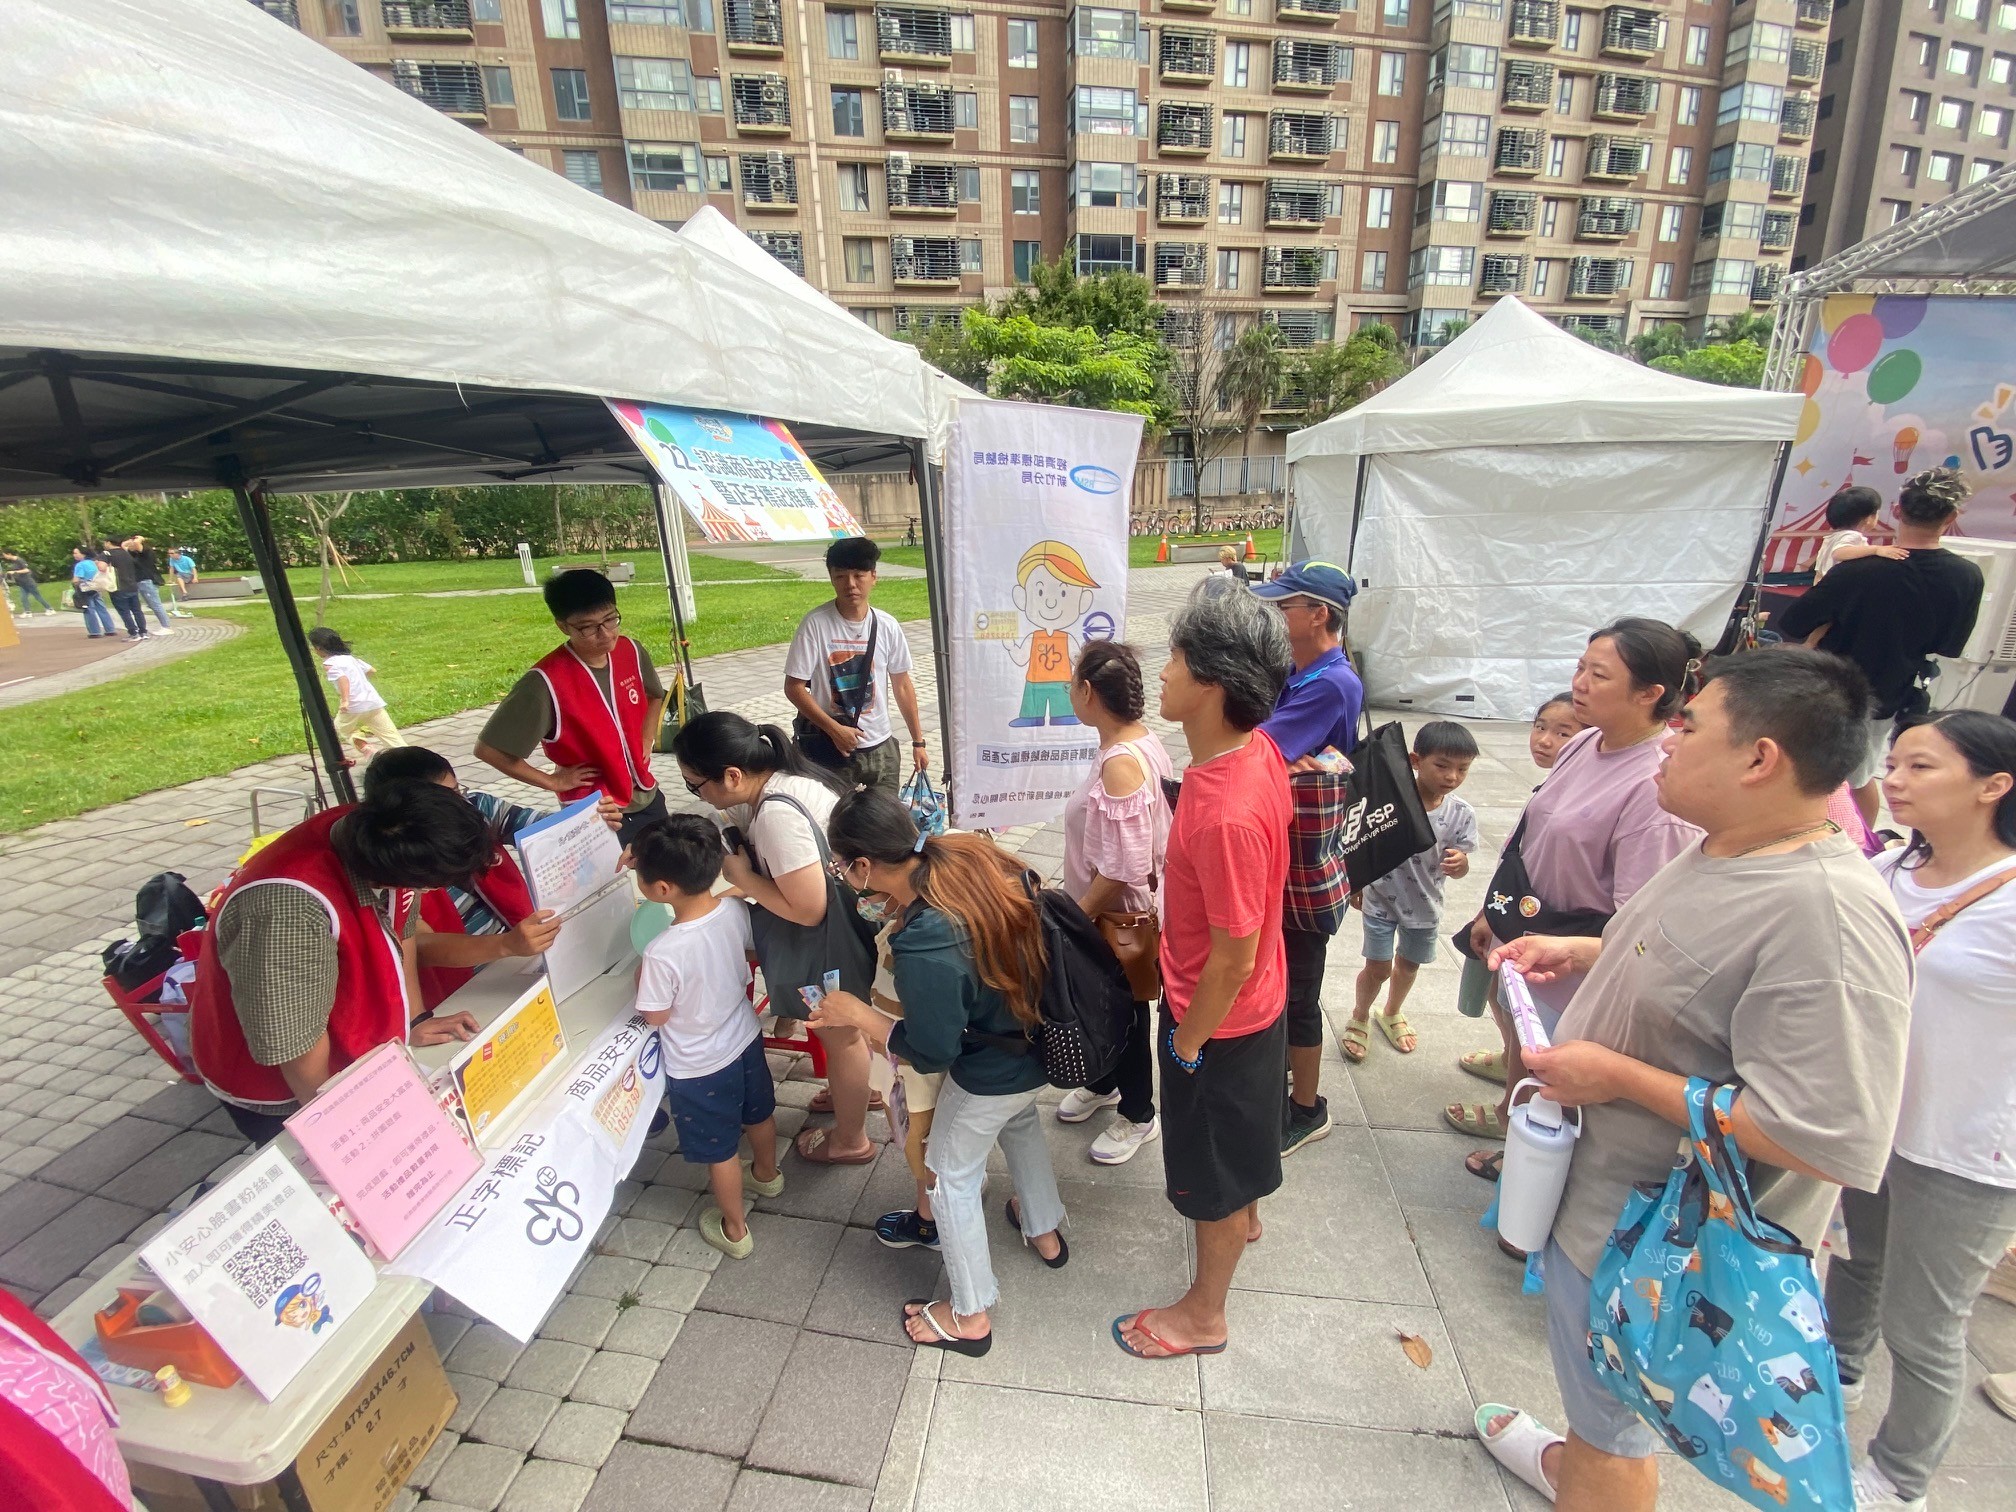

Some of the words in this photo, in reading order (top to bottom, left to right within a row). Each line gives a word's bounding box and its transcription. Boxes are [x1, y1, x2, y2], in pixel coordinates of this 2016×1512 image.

[1360, 827, 1380, 843] NEVER
[1380, 818, 1398, 832] ENDS
[1366, 803, 1394, 828] FSP
[445, 1133, 546, 1232] 正字標記
[167, 1164, 284, 1267] 小安心臉書粉絲團
[184, 1185, 296, 1286] 加入即可獲得精美禮品
[366, 1408, 382, 1433] 2.7
